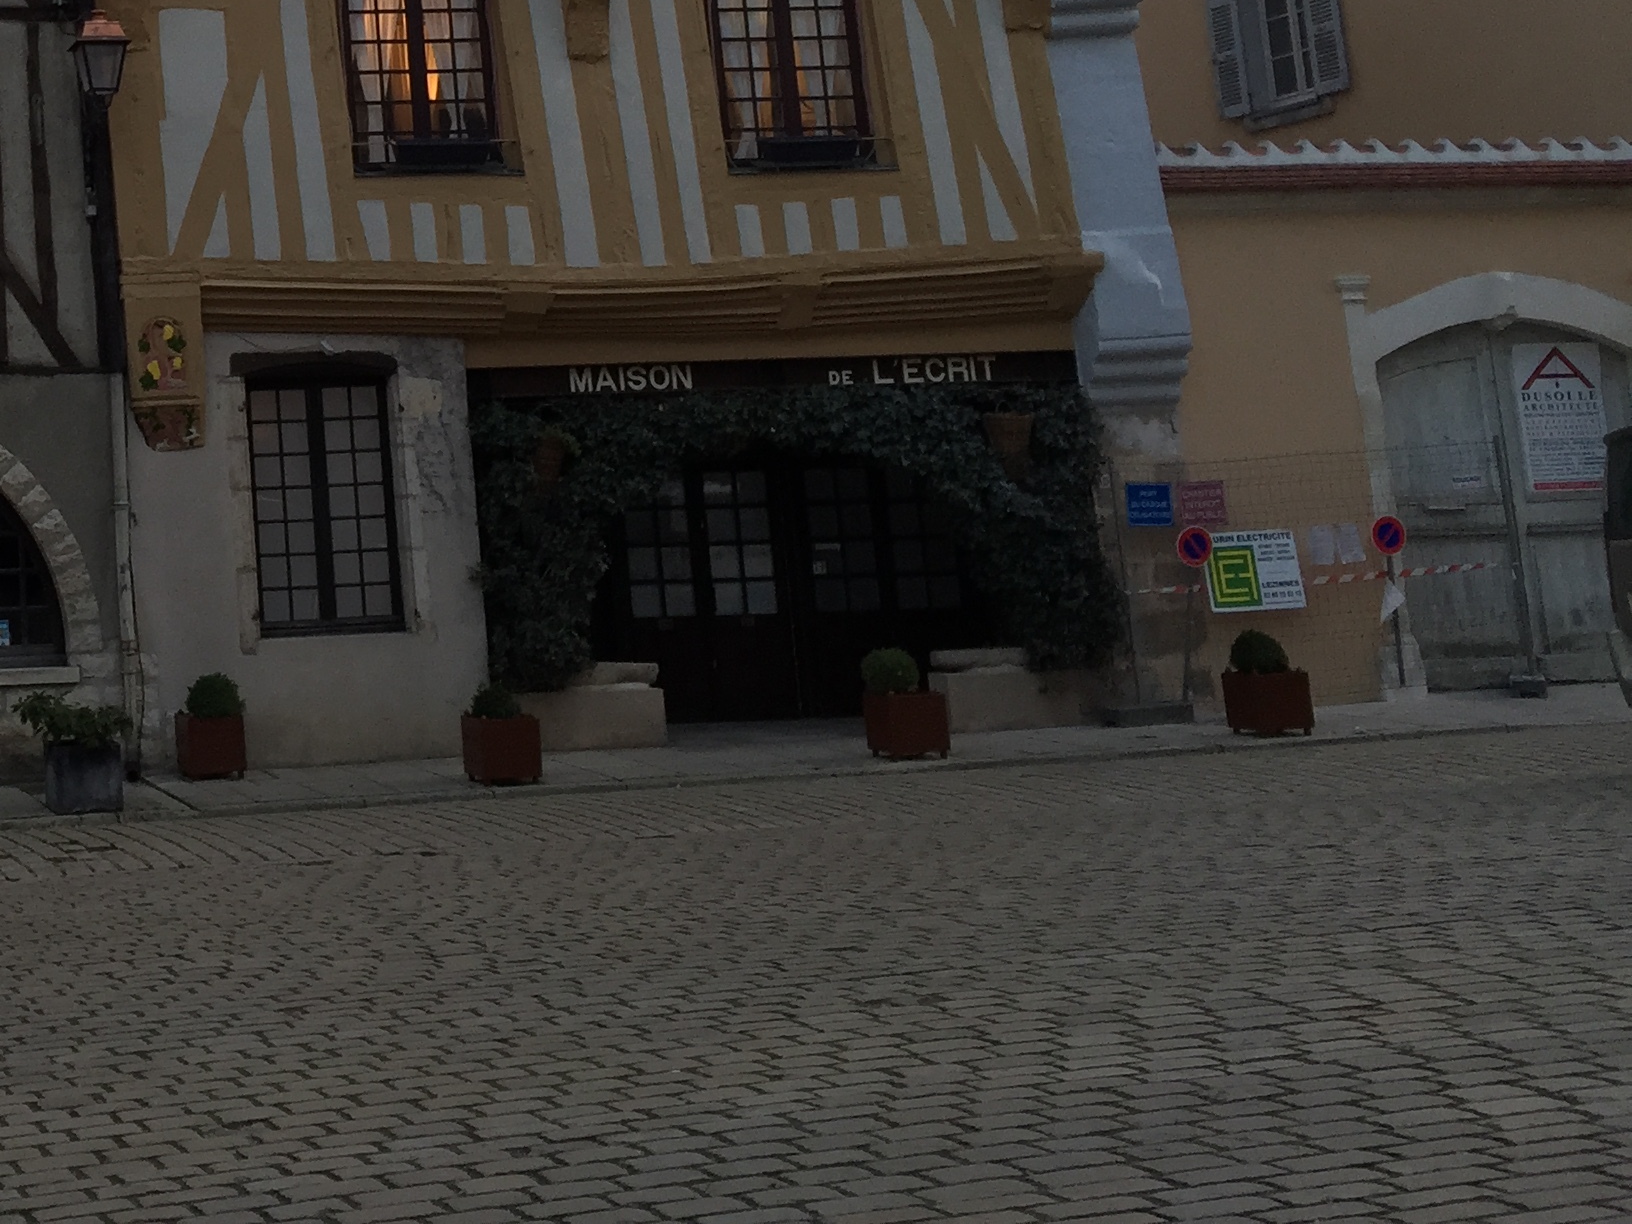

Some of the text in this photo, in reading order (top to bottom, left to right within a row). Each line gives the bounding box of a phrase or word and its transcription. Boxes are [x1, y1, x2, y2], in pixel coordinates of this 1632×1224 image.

[569, 364, 693, 393] MAISON
[828, 370, 854, 386] DE
[1212, 534, 1234, 543] URIN
